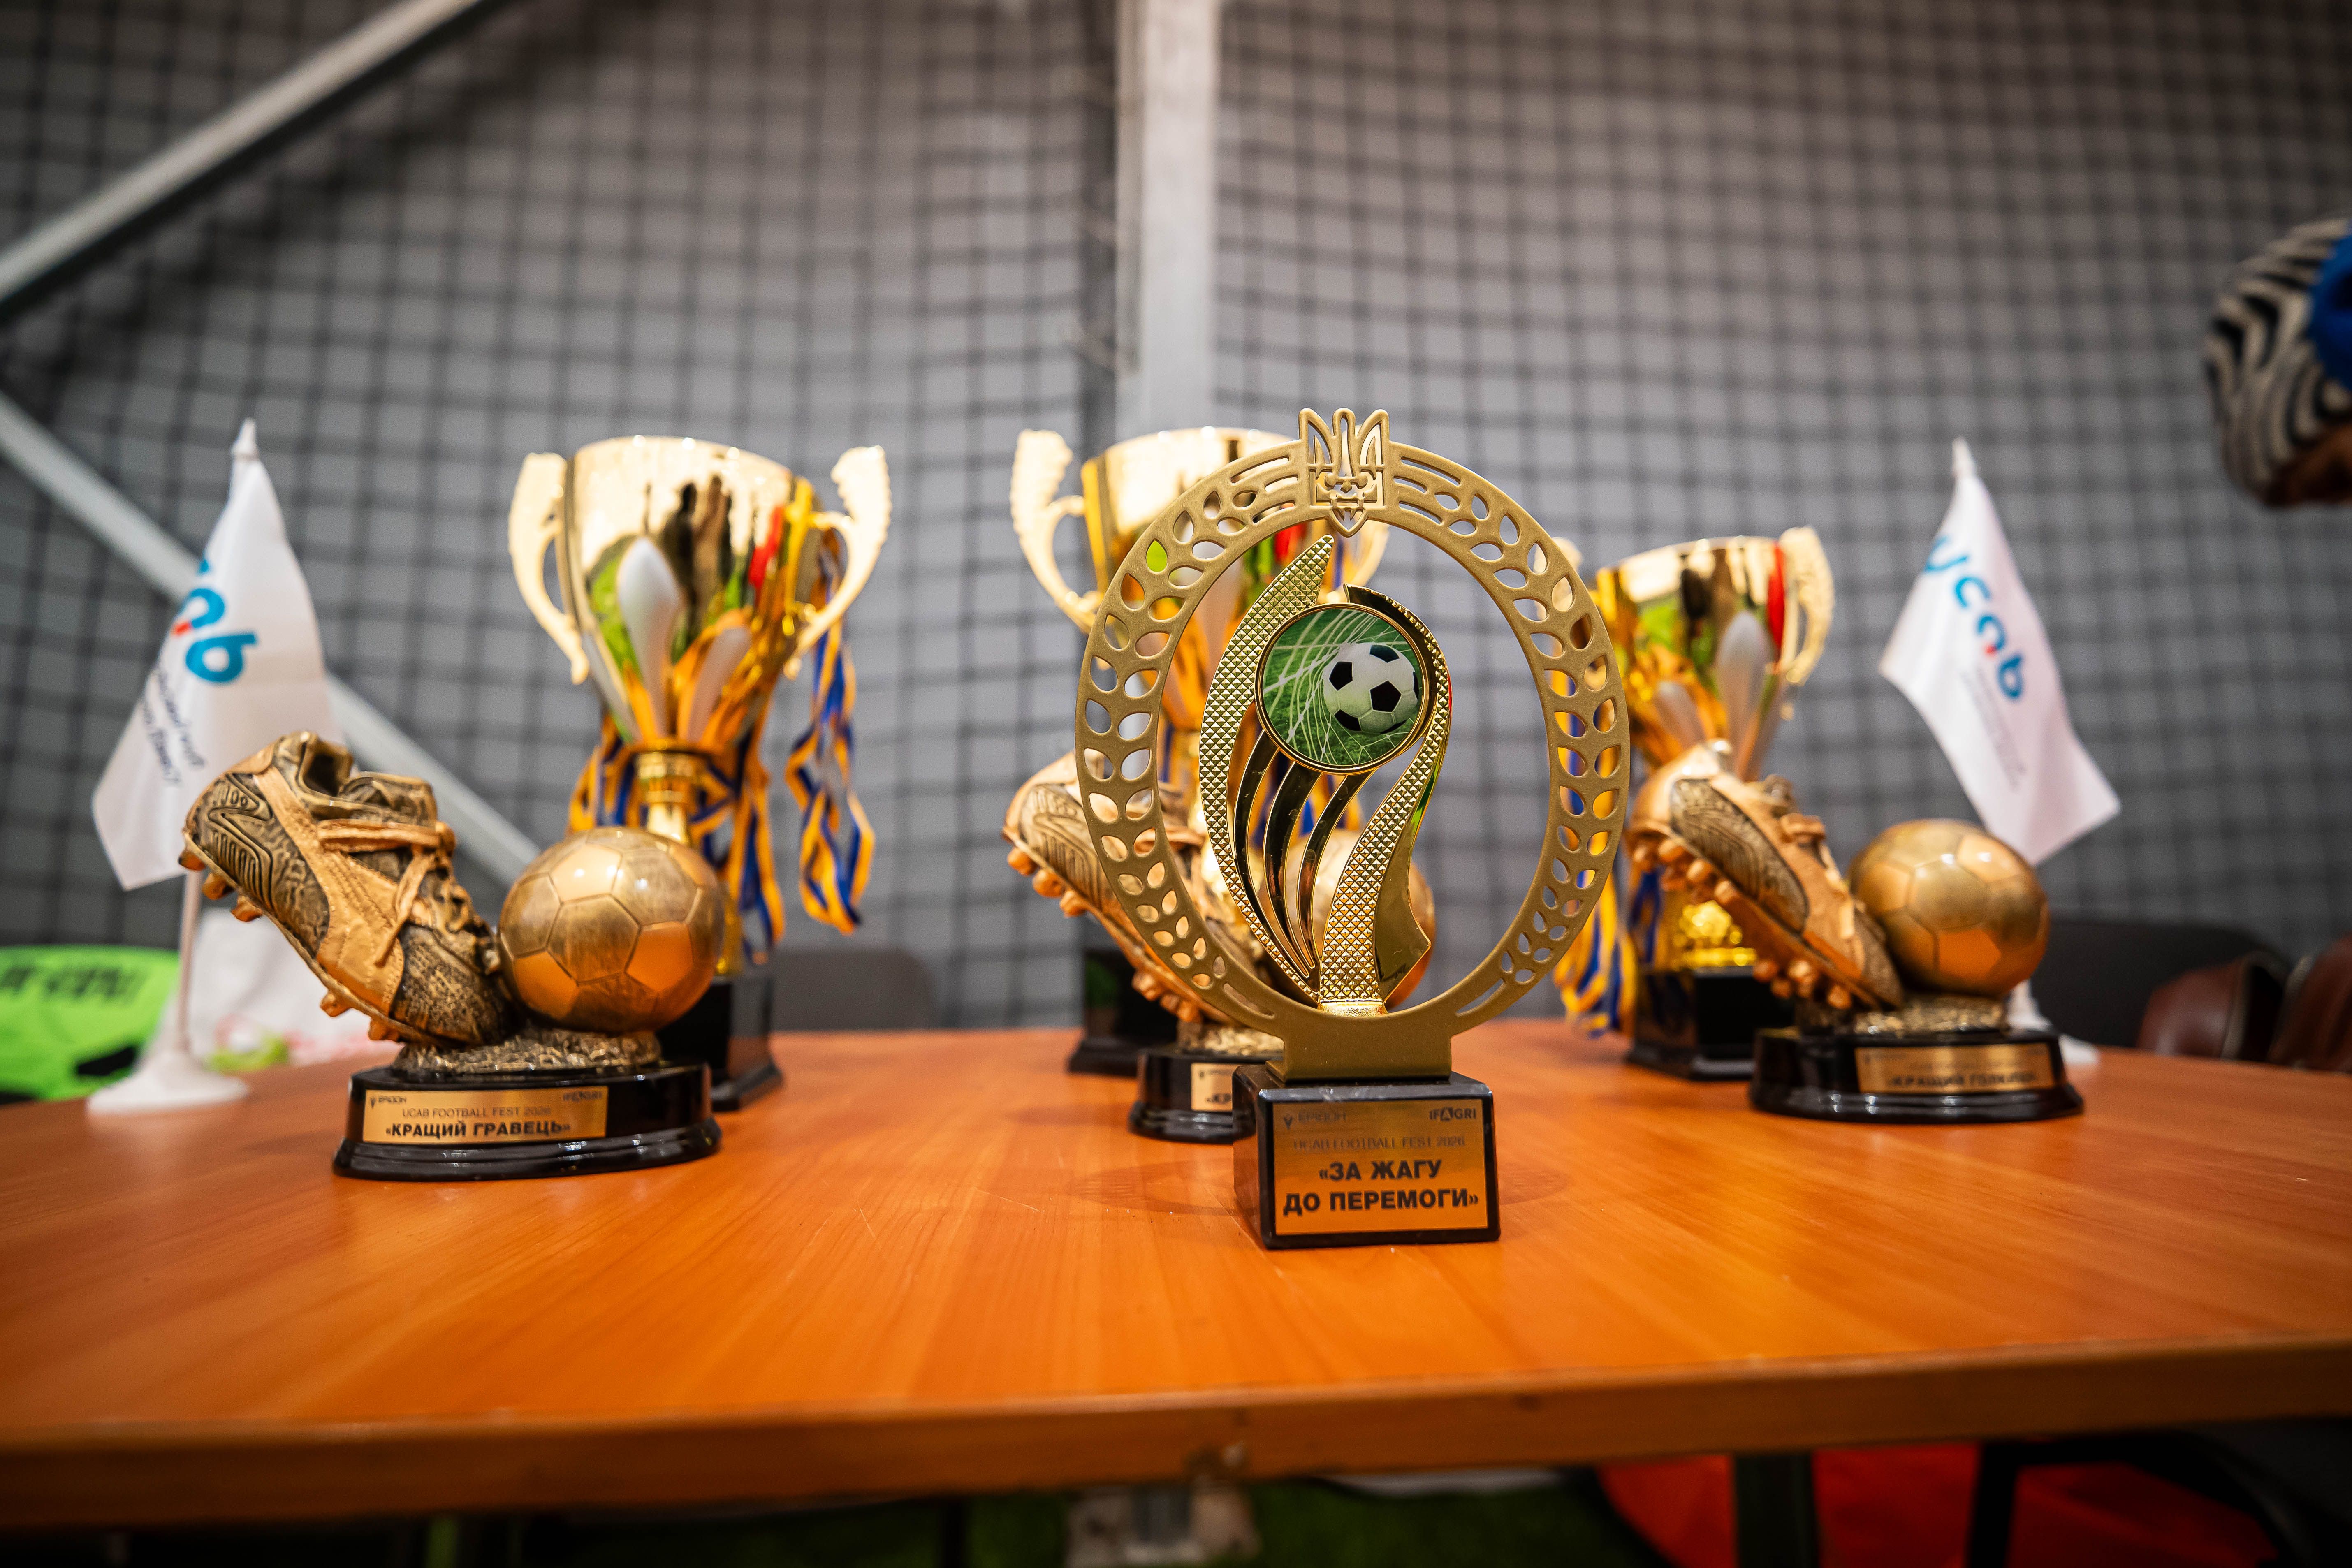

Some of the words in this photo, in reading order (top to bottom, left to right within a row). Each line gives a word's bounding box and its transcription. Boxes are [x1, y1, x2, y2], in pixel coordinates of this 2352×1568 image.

[403, 1108, 429, 1117] UCAB
[433, 1107, 486, 1118] FOOTBALL
[493, 1106, 519, 1116] FEST
[386, 1120, 466, 1140] «КРАЩИЙ
[474, 1120, 570, 1137] ГРАВЕЦЬ»
[1402, 1136, 1431, 1148] FEST
[1319, 1162, 1362, 1181] «ЗА
[1370, 1160, 1441, 1179] ЖАГУ
[1283, 1193, 1320, 1216] ДО
[1330, 1188, 1479, 1211] ПЕРЕМОГИ»
